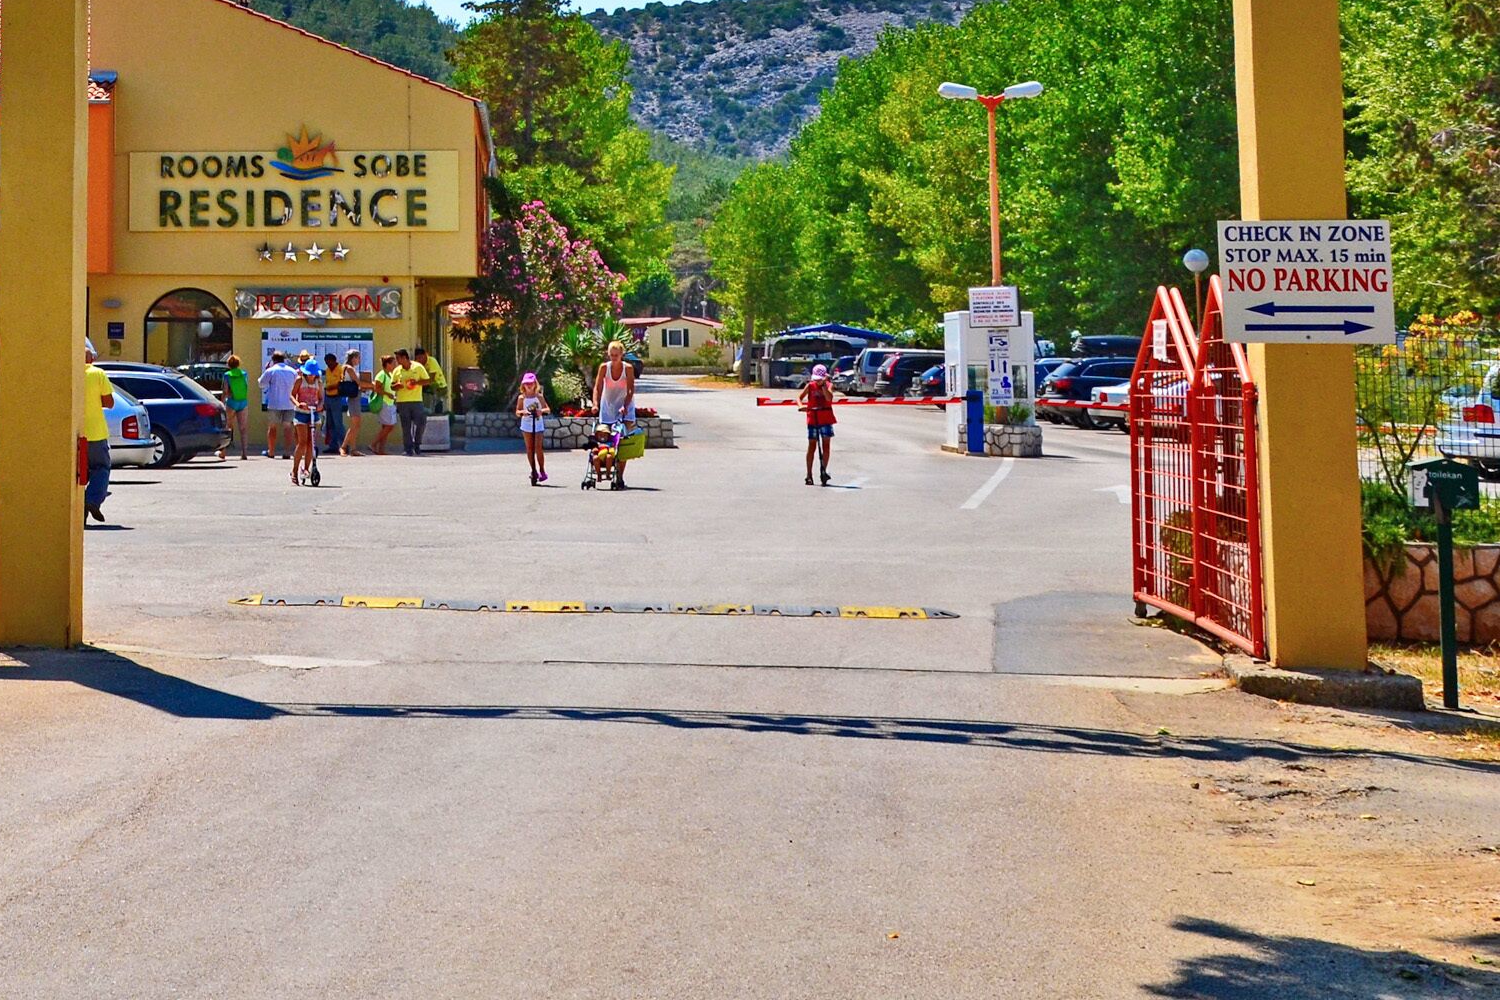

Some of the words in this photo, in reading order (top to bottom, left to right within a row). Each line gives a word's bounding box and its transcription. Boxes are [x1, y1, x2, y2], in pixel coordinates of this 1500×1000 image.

[160, 155, 265, 179] ROOMS
[353, 154, 427, 179] SOBE
[158, 188, 428, 228] RESIDENCE
[1224, 226, 1294, 242] CHECK
[1299, 226, 1321, 242] IN
[1328, 226, 1385, 242] ZONE
[1225, 248, 1271, 263] STOP
[1276, 248, 1324, 263] MAX.
[1330, 249, 1349, 263] 15
[1354, 248, 1386, 263] min
[1228, 268, 1266, 292] NO
[1273, 268, 1388, 293] PARKING
[255, 294, 382, 313] RECEPTION
